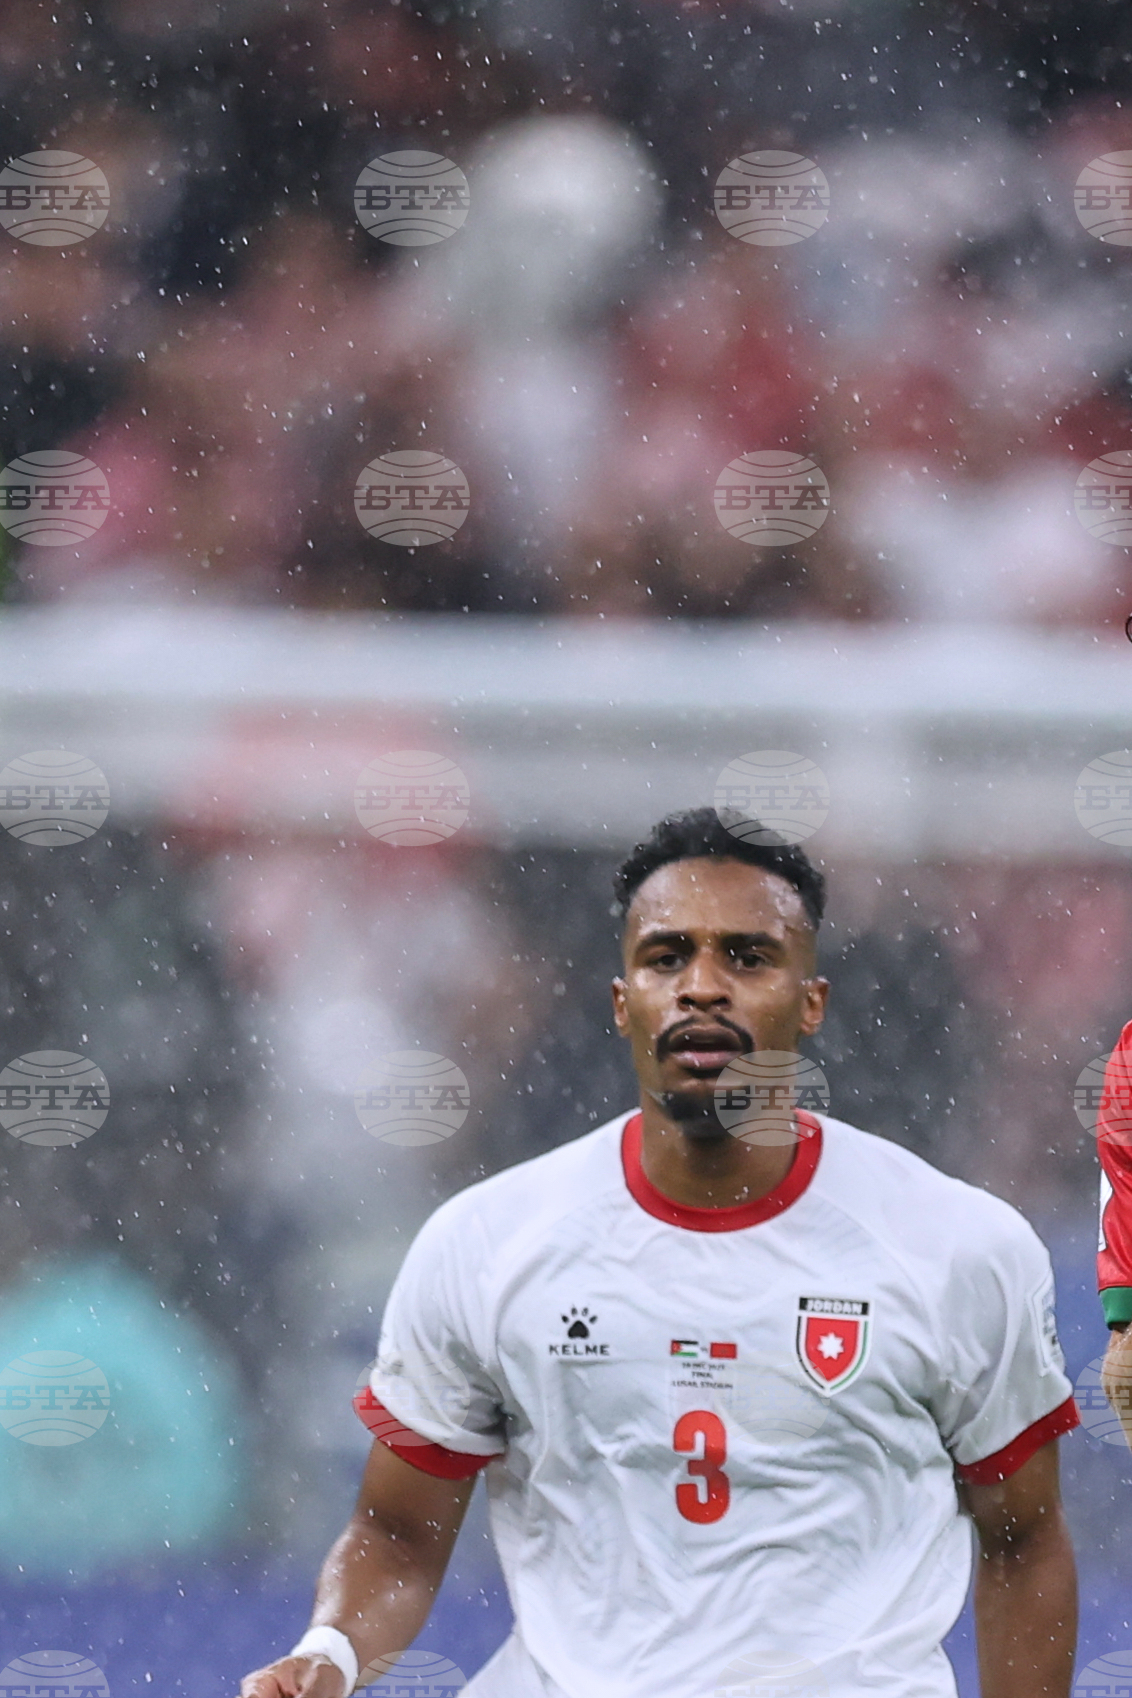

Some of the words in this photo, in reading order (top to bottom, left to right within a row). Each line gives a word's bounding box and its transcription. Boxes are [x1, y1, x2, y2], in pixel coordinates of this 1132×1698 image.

[806, 1299, 863, 1315] JORDAN
[548, 1343, 611, 1356] KELME
[672, 1409, 731, 1524] 3
